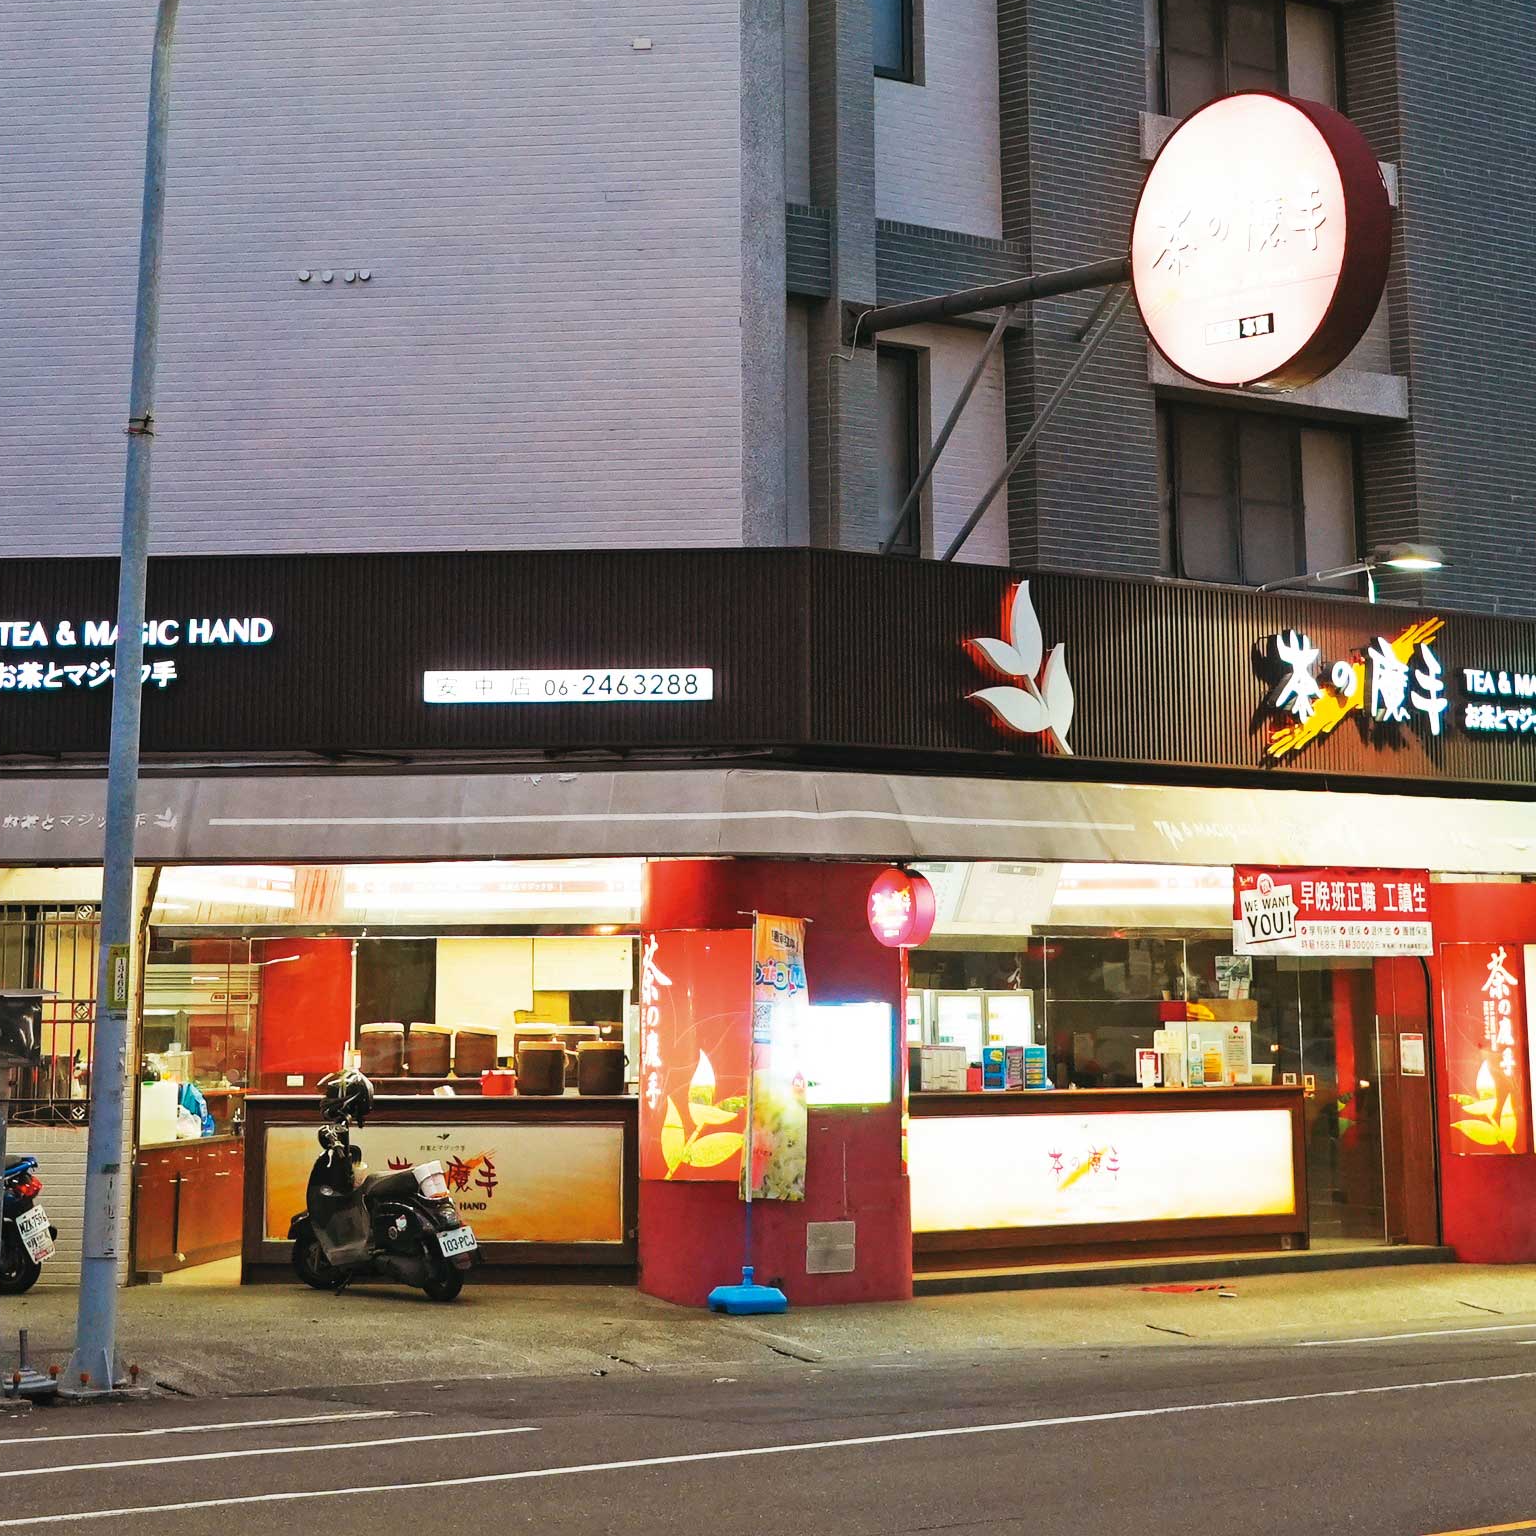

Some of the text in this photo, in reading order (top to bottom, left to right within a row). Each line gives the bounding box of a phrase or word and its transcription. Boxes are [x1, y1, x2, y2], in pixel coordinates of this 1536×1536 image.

[55, 620, 77, 647] &
[189, 617, 274, 644] HAND
[544, 673, 699, 696] 06-2463288
[1275, 629, 1448, 736] 茶の魔手
[1463, 668, 1496, 694] TEA
[1498, 671, 1512, 695] &
[2, 813, 146, 830] お茶とマジッ手
[1245, 895, 1290, 912] WE WANT
[1300, 880, 1377, 912] 早晚班正職
[1383, 882, 1427, 913] 工讀生
[1247, 910, 1292, 937] YOU!
[459, 1202, 487, 1211] HAND
[443, 1235, 475, 1253] 103-PCJ
